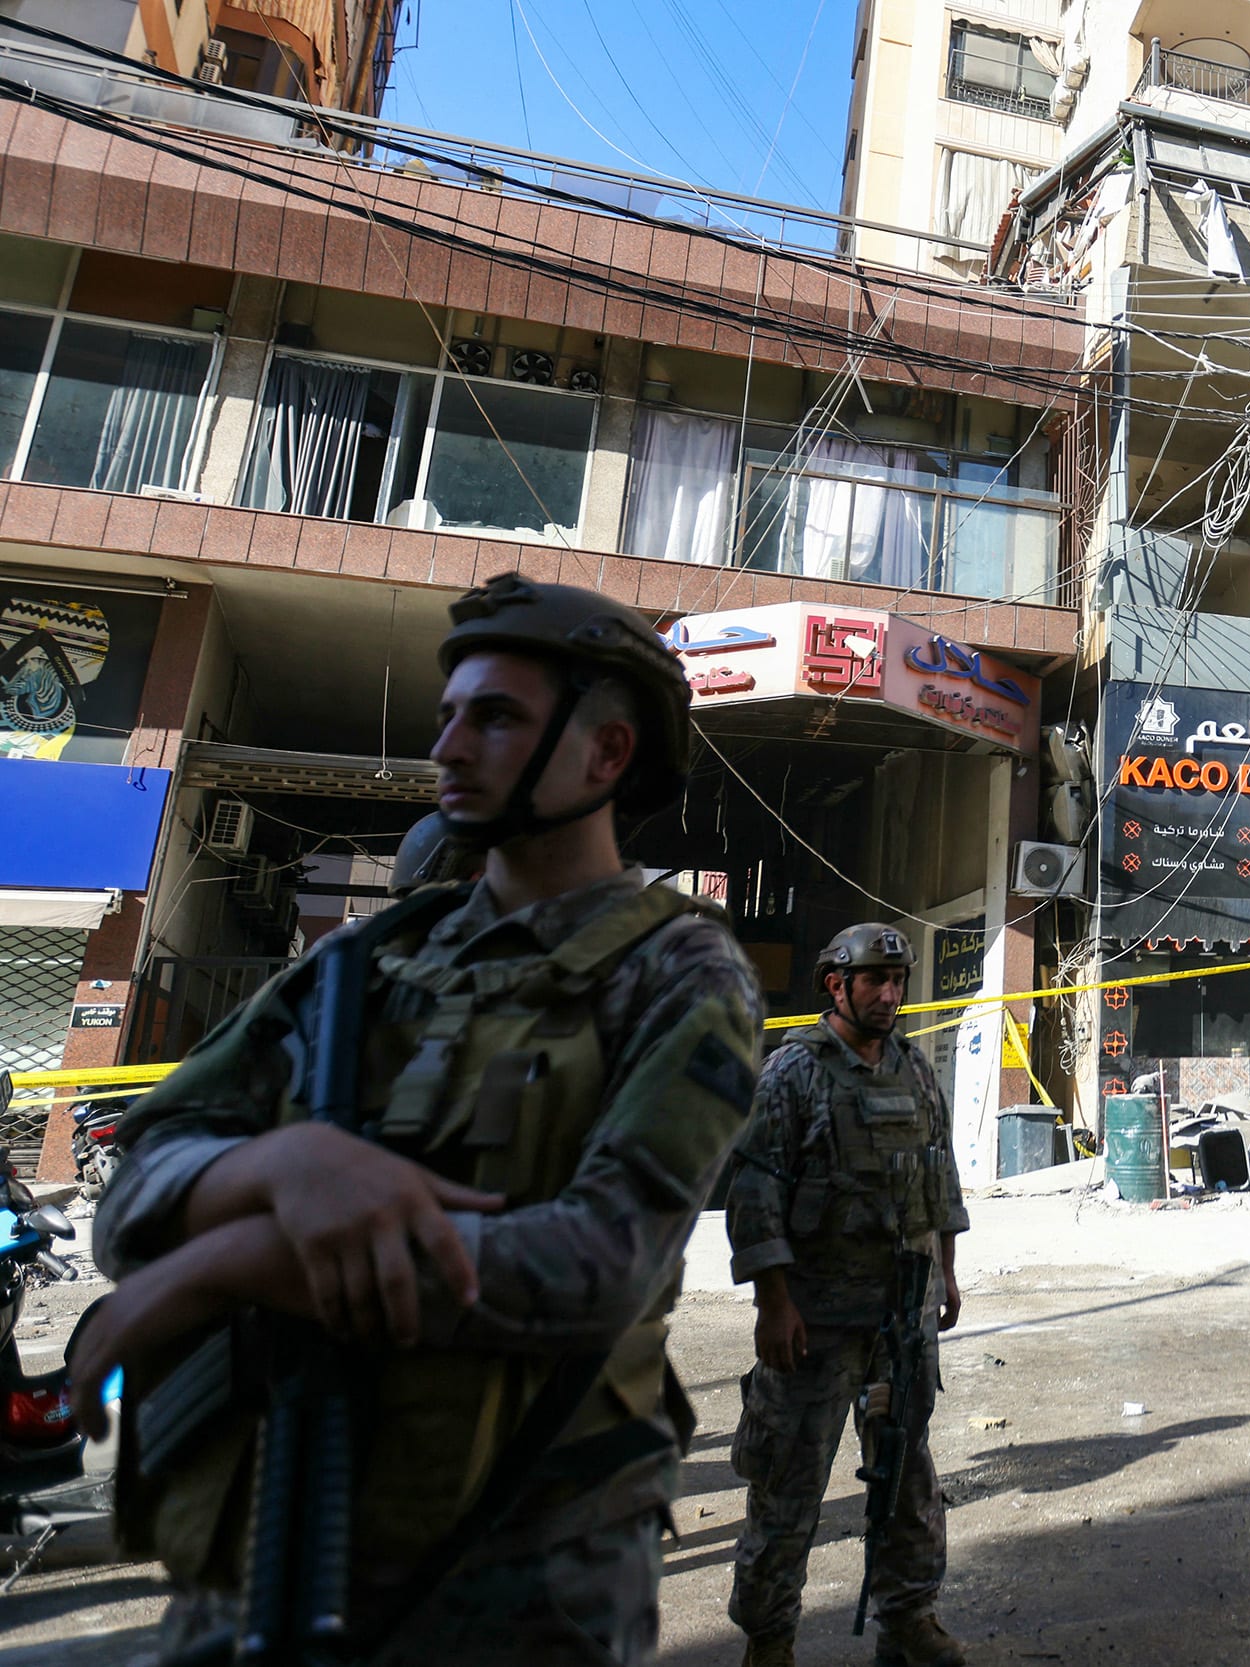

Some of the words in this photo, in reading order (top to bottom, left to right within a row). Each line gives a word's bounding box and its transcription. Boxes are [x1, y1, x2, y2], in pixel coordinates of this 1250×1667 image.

[904, 634, 1030, 705] حلال
[1119, 755, 1228, 792] KACO
[1153, 824, 1185, 837] تركية
[1188, 825, 1225, 839] شاورما
[1189, 858, 1225, 873] مشاوي
[81, 1018, 113, 1026] YUKON
